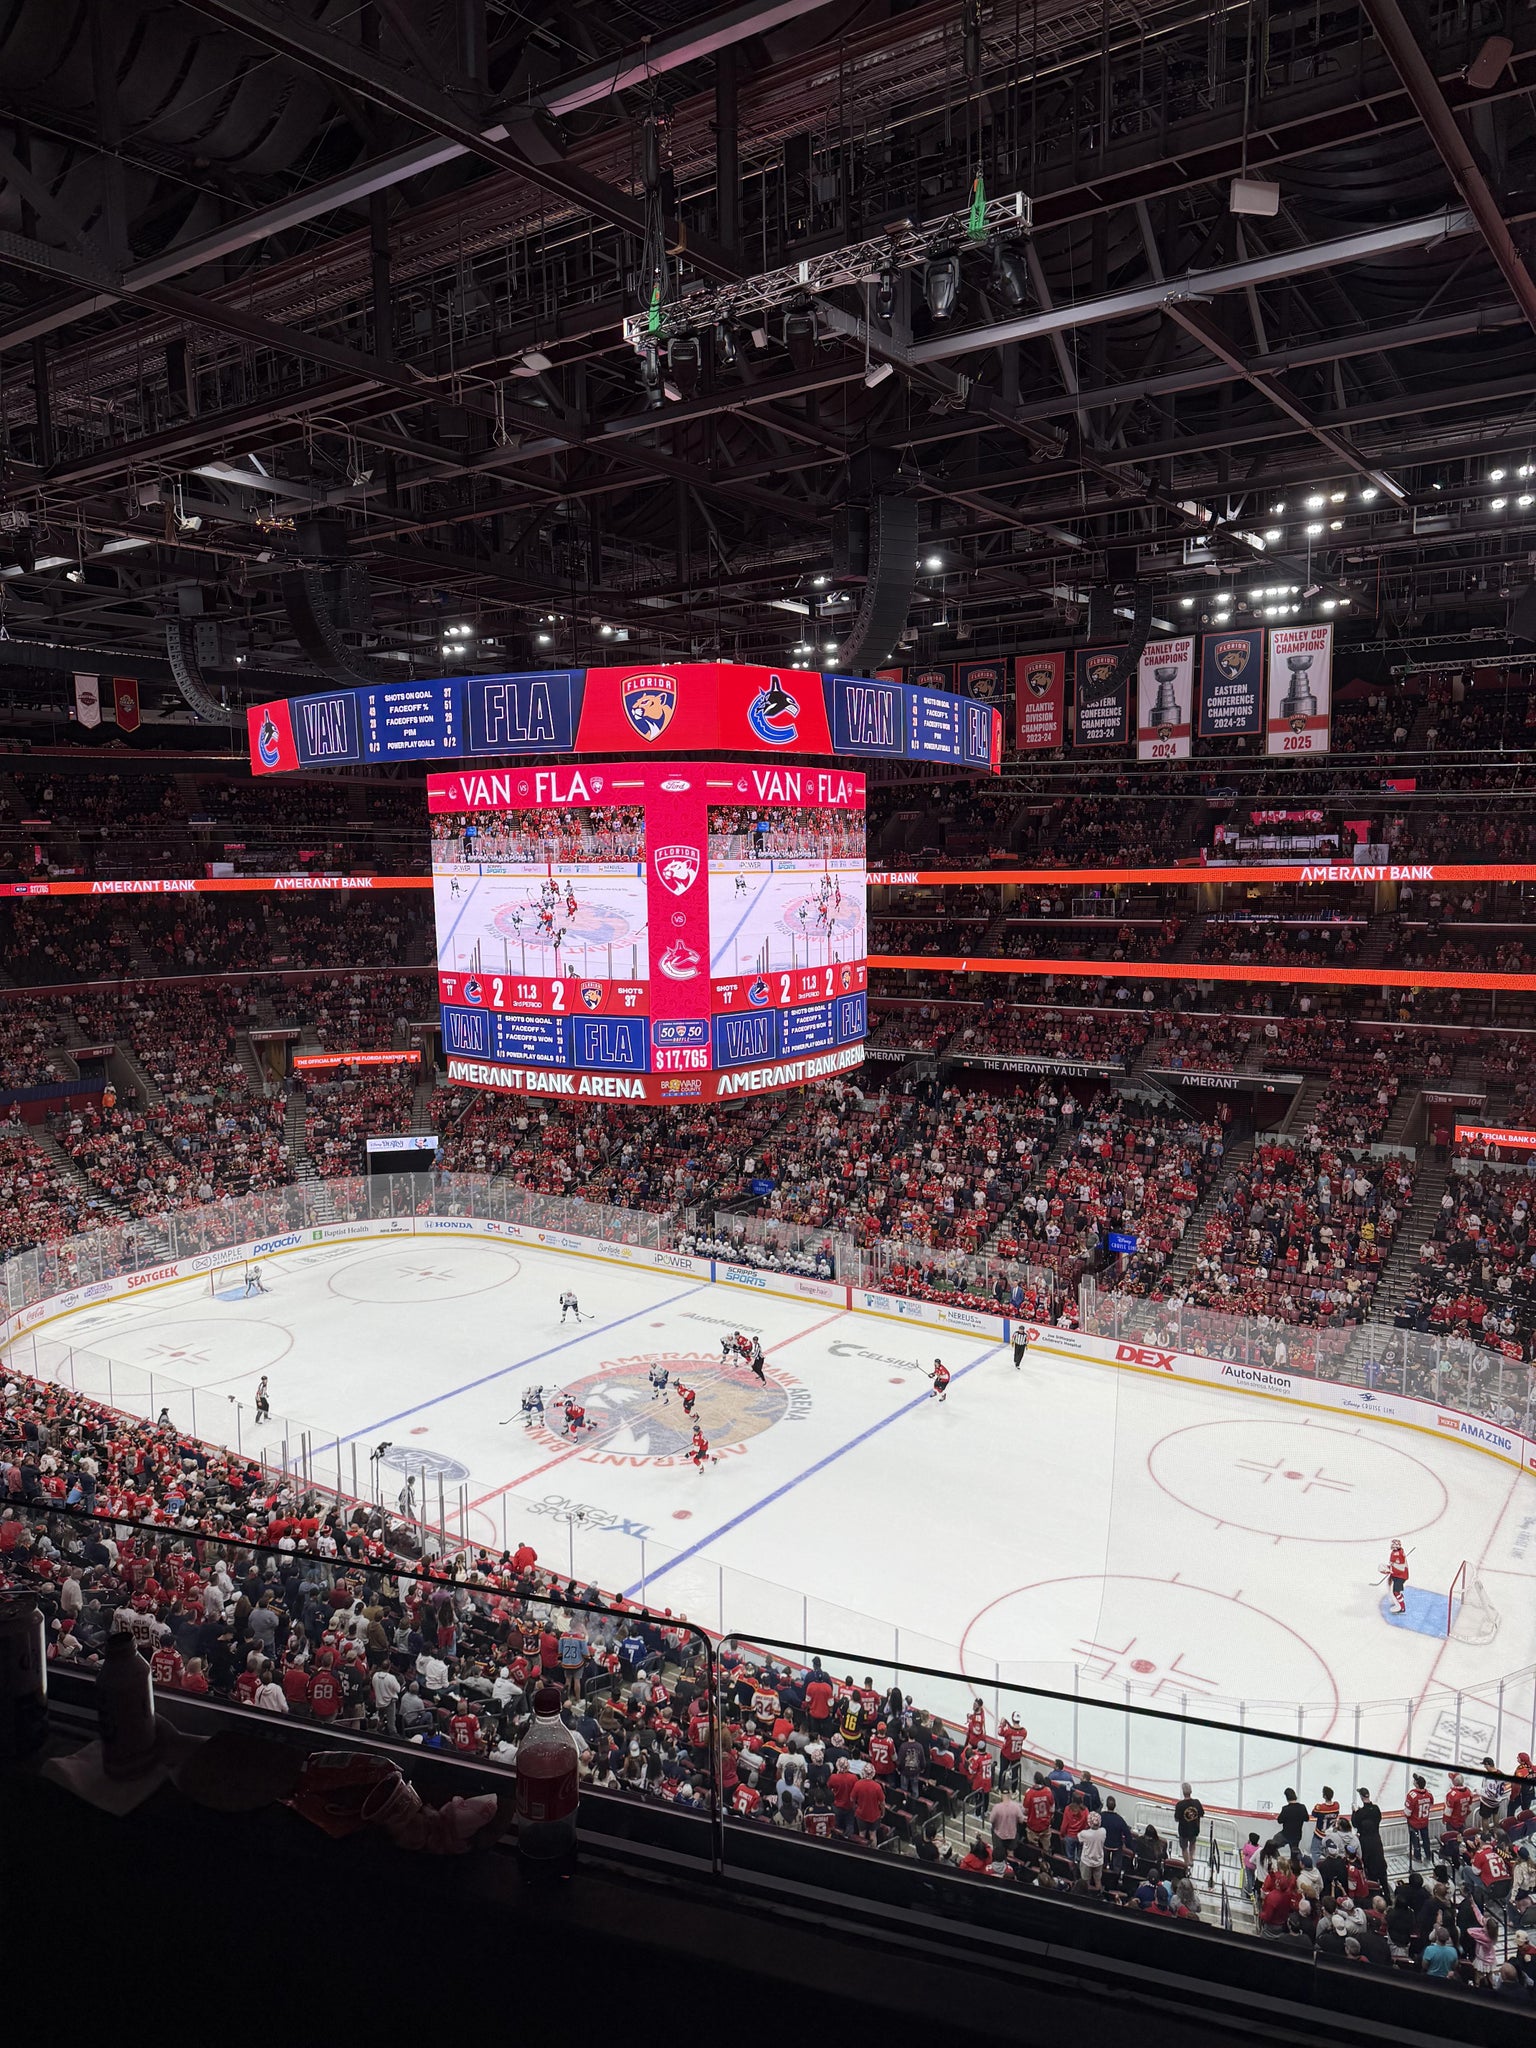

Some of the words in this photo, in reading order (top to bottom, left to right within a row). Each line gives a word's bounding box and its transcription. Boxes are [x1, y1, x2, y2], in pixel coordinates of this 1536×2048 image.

[1274, 631, 1308, 643] STANLEY
[1311, 629, 1328, 639] CUP
[1142, 644, 1172, 656] STANLEY
[1175, 642, 1190, 651] CUP
[1218, 643, 1247, 651] FLORIDA
[1276, 639, 1325, 654] CHAMPIONS
[1144, 653, 1188, 666] CHAMPIONS
[627, 677, 672, 690] FLORIDA
[1214, 684, 1248, 695] EASTERN
[385, 693, 405, 702] SHOTS
[405, 692, 414, 700] ON
[415, 691, 432, 699] GOAL
[1207, 695, 1254, 706] CONFERENCE
[390, 704, 421, 713] FACEOFF
[484, 682, 555, 742] FLA
[1025, 702, 1054, 712] ATLANTIC
[1080, 707, 1122, 718] CONFERENCE
[1208, 706, 1253, 718] CHAMPIONS
[386, 716, 417, 726] FACEOFFS
[418, 715, 434, 724] WON
[846, 687, 893, 745] VAN
[1026, 713, 1053, 722] DIVISION
[1214, 718, 1246, 728] 2024-25
[303, 700, 348, 756] VAN
[1021, 723, 1057, 733] CHAMPIONS
[1082, 718, 1121, 729] CHAMPIONS
[970, 708, 988, 759] FLA
[1026, 733, 1052, 743] 2023-24
[1087, 730, 1115, 739] 2023-24
[1284, 736, 1312, 750] 2025
[1152, 743, 1176, 758] 2024
[460, 775, 510, 806] VAN
[519, 784, 527, 792] VS
[535, 771, 591, 803] FLA
[666, 781, 685, 789] Ford
[752, 771, 801, 801] VAN
[818, 774, 848, 803] FLA
[659, 848, 696, 857] FLORIDA
[890, 873, 919, 883] BANK
[1300, 866, 1387, 880] AMERANT
[1390, 866, 1433, 879] BANK
[92, 881, 160, 893] AMERANT
[163, 880, 196, 891] BANK
[274, 878, 339, 889] AMERANT
[342, 878, 373, 888] BANK
[716, 984, 738, 992] SHOTS
[781, 974, 790, 1003] 2
[802, 975, 816, 990] 11.3
[826, 968, 833, 996] 2
[492, 978, 504, 1007] 2
[517, 984, 537, 999] 11.3
[551, 981, 565, 1011] 2
[618, 987, 643, 995] SHOTS
[723, 992, 732, 1004] 17
[624, 995, 636, 1007] 37
[842, 1000, 862, 1036] FLA
[450, 1013, 482, 1050] VAN
[506, 1033, 538, 1041] FACEOFFS
[661, 1027, 674, 1038] 50
[688, 1027, 701, 1036] 50
[726, 1018, 768, 1059] VAN
[585, 1024, 633, 1063] FLA
[656, 1049, 707, 1070] $17,765
[865, 1052, 905, 1062] AMERANT
[717, 1059, 804, 1096] AMERANT
[806, 1053, 838, 1078] BANK
[837, 1044, 866, 1069] ARENA
[983, 1060, 1000, 1070] THE
[1002, 1062, 1050, 1074] AMERANT
[1053, 1065, 1089, 1077] VAULT
[448, 1060, 525, 1089] AMERANT
[526, 1073, 575, 1096] BANK
[578, 1075, 647, 1100] ARENA
[1182, 1076, 1239, 1088] AMERANT
[324, 1228, 347, 1237] Baptist
[348, 1225, 369, 1234] Health
[253, 1234, 301, 1256] payactiv
[212, 1248, 242, 1262] SIMPLE
[654, 1254, 692, 1269] iPOWER
[127, 1265, 179, 1288] SEATGEEK
[727, 1267, 758, 1277] SCRIPPS
[725, 1273, 766, 1287] SPORTS
[948, 1311, 975, 1322] NEREUS
[856, 1350, 918, 1370] CELSIUS
[1115, 1344, 1176, 1371] DEX
[1225, 1366, 1291, 1388] AutoNation
[784, 1387, 812, 1421] ARENA
[1362, 1403, 1381, 1412] CRUISE
[1460, 1423, 1512, 1450] AMAZING
[542, 1494, 618, 1526] OMEGA
[526, 1502, 606, 1531] SPORT
[601, 1518, 655, 1540] XL
[564, 1646, 577, 1658] 23
[628, 1649, 635, 1662] 7
[314, 1685, 333, 1699] 68
[845, 1715, 857, 1730] 16
[1012, 1740, 1022, 1753] 16
[873, 1749, 889, 1764] 72
